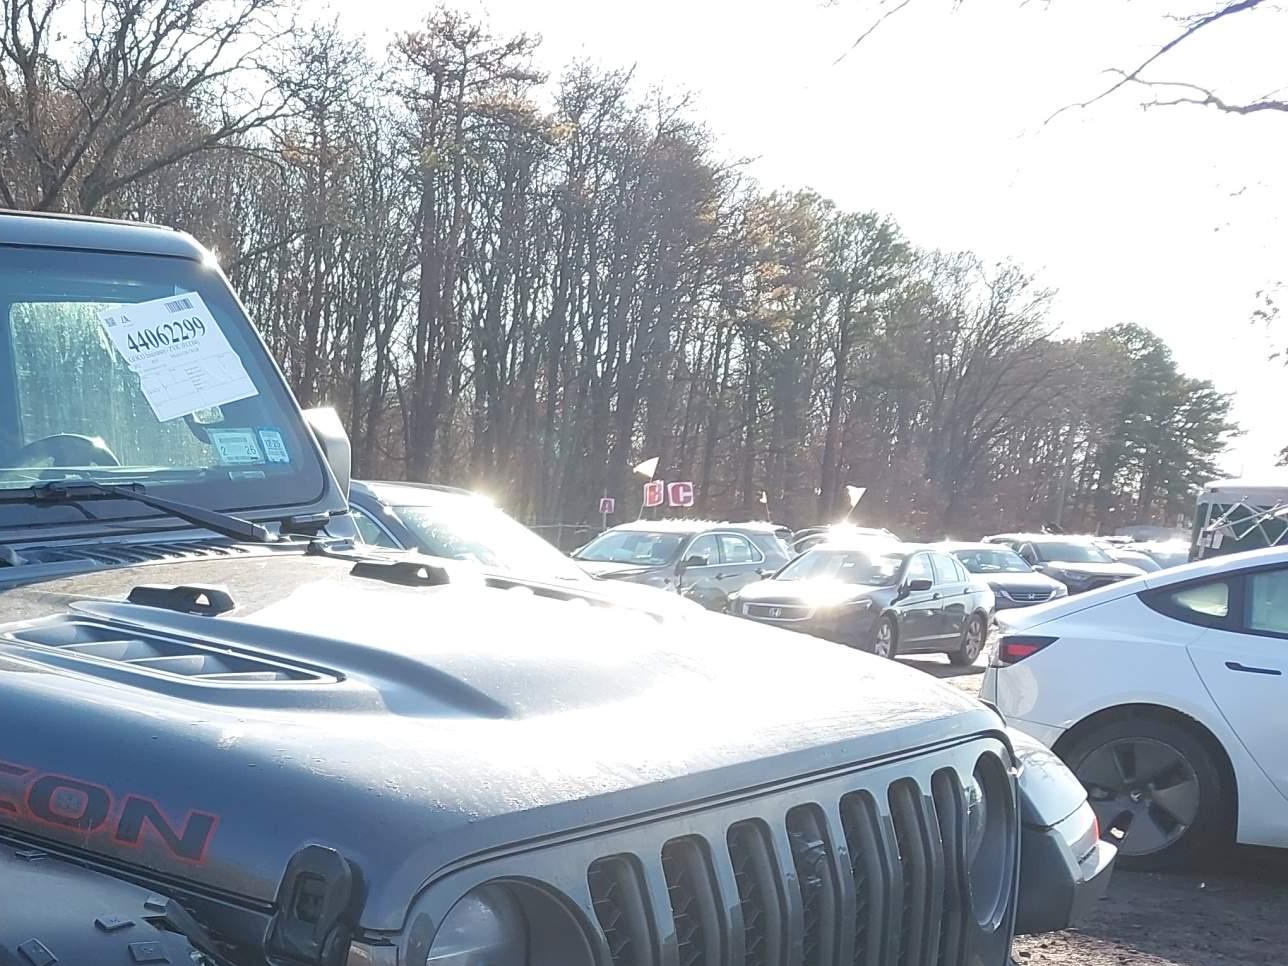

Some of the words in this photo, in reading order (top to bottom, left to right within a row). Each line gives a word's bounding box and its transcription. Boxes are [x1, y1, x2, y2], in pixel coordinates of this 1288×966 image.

[127, 316, 206, 353] 44062299
[671, 483, 692, 505] C
[601, 499, 613, 513] A
